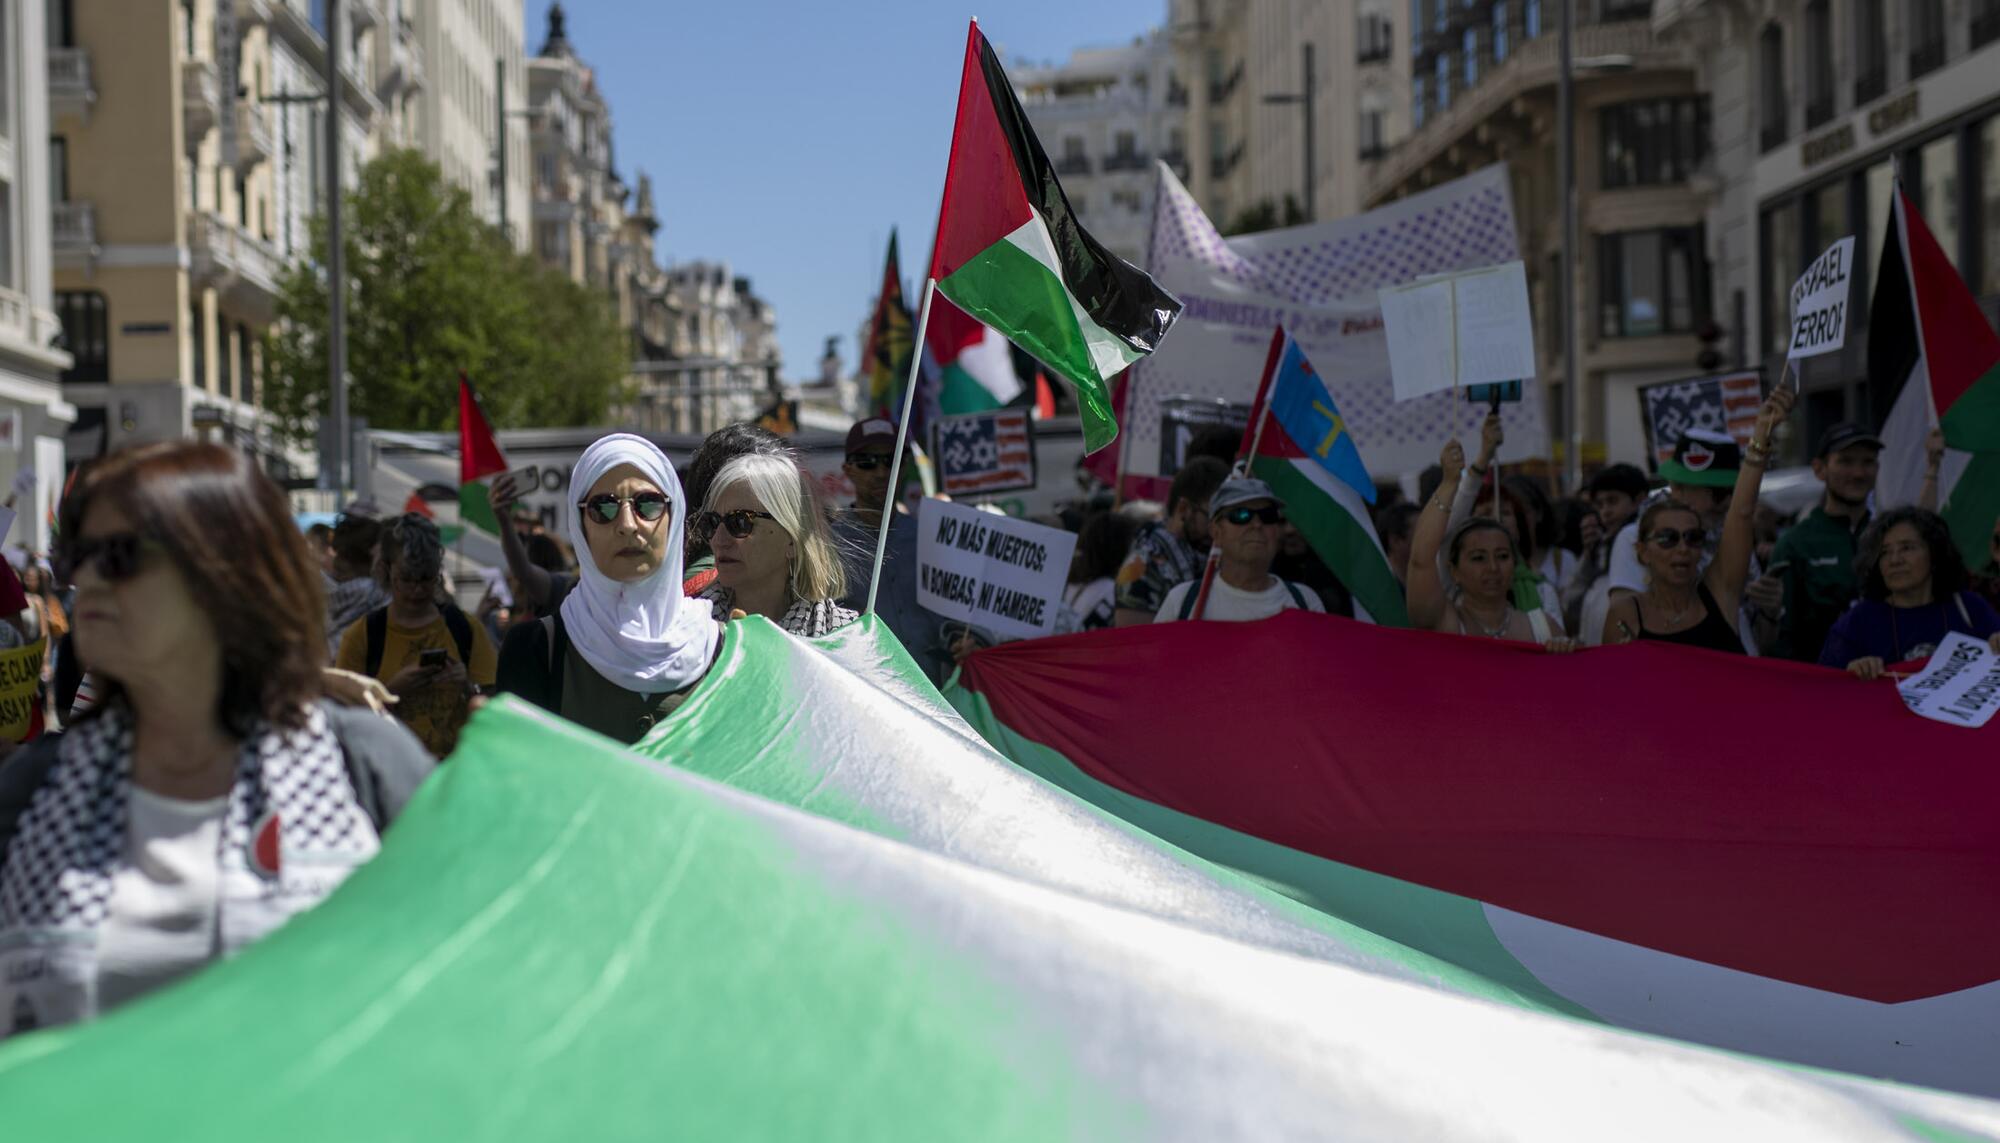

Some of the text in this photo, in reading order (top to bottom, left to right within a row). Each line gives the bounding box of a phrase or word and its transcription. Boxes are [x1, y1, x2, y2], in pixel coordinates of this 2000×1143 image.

[936, 516, 1047, 573] NO MÁS MUERTOS:
[921, 562, 1047, 627] NI BOMBAS, NI HAMBRE.
